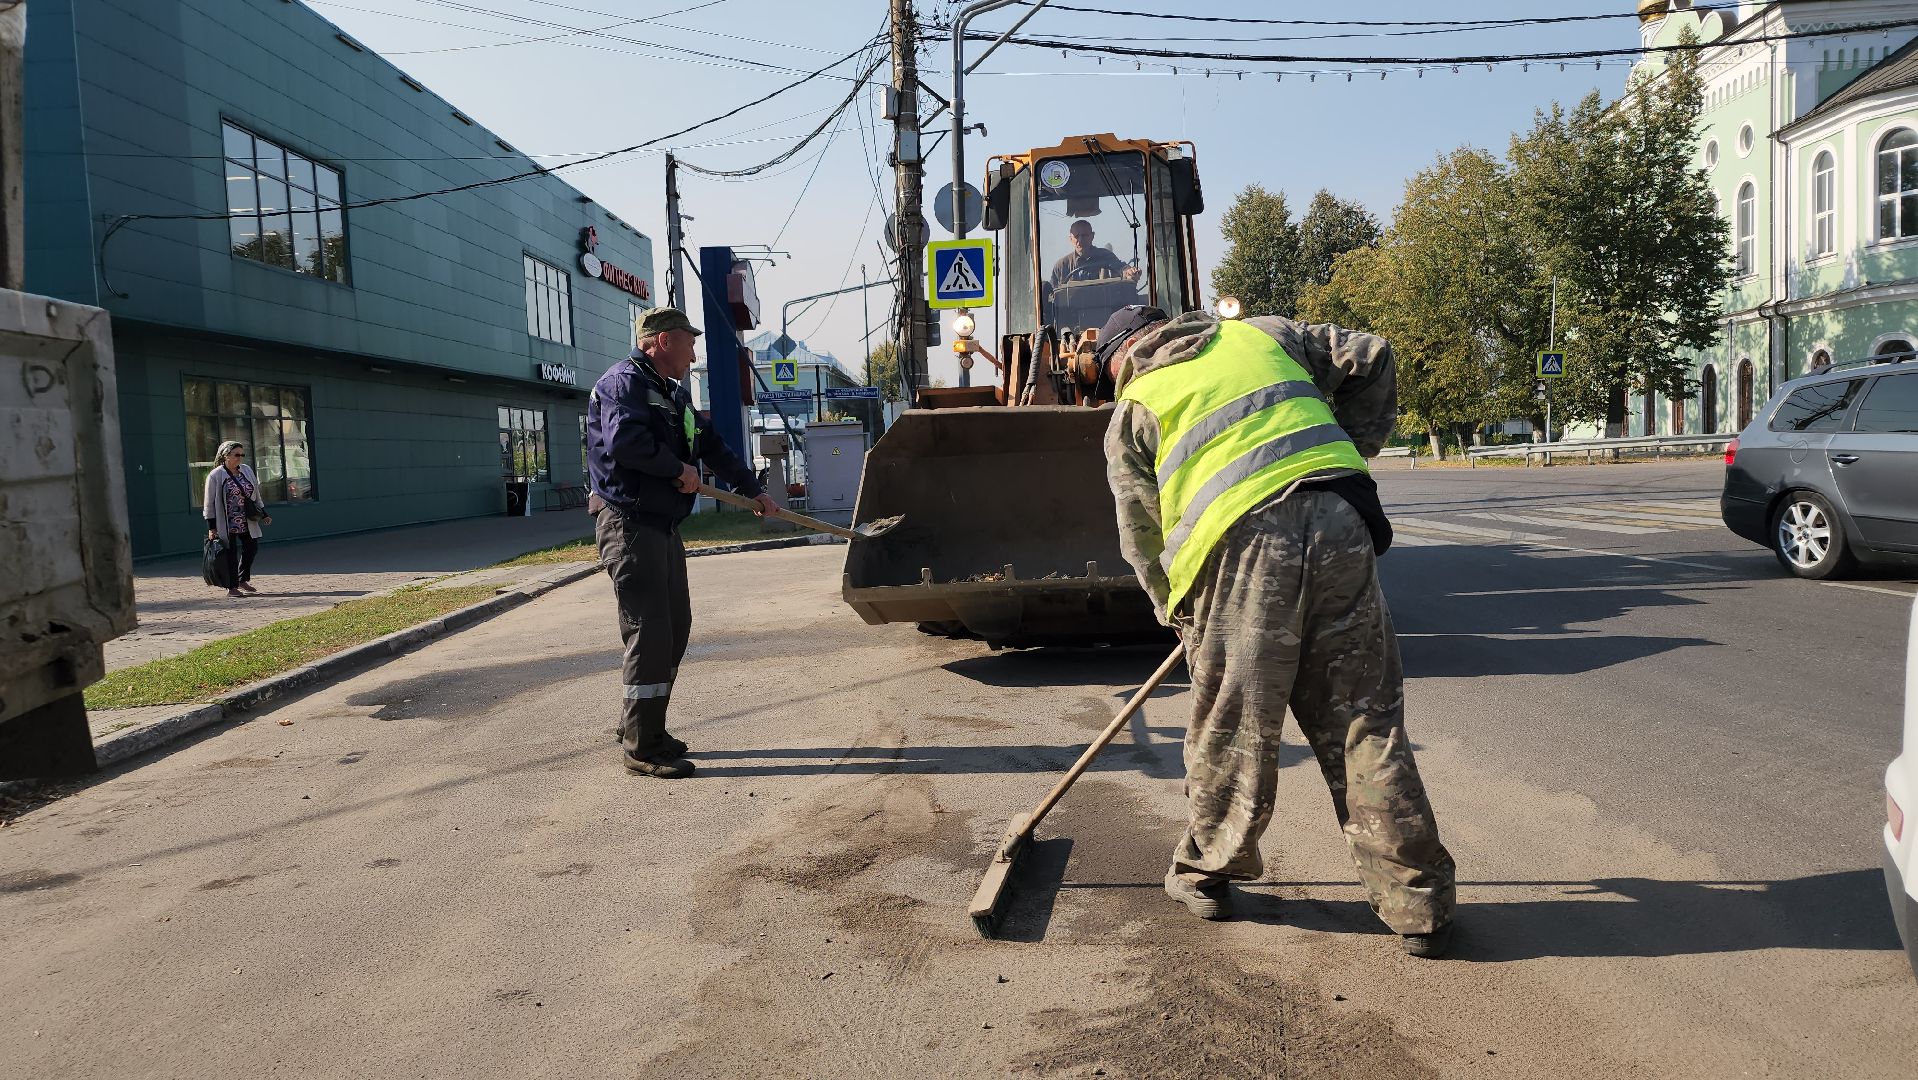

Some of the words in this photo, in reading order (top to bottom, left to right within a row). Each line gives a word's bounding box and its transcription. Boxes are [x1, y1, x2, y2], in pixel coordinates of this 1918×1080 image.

[603, 262, 633, 291] ФИТНЕС
[633, 276, 650, 299] КЛУБ
[542, 363, 576, 385] КОФЕЙНЯ
